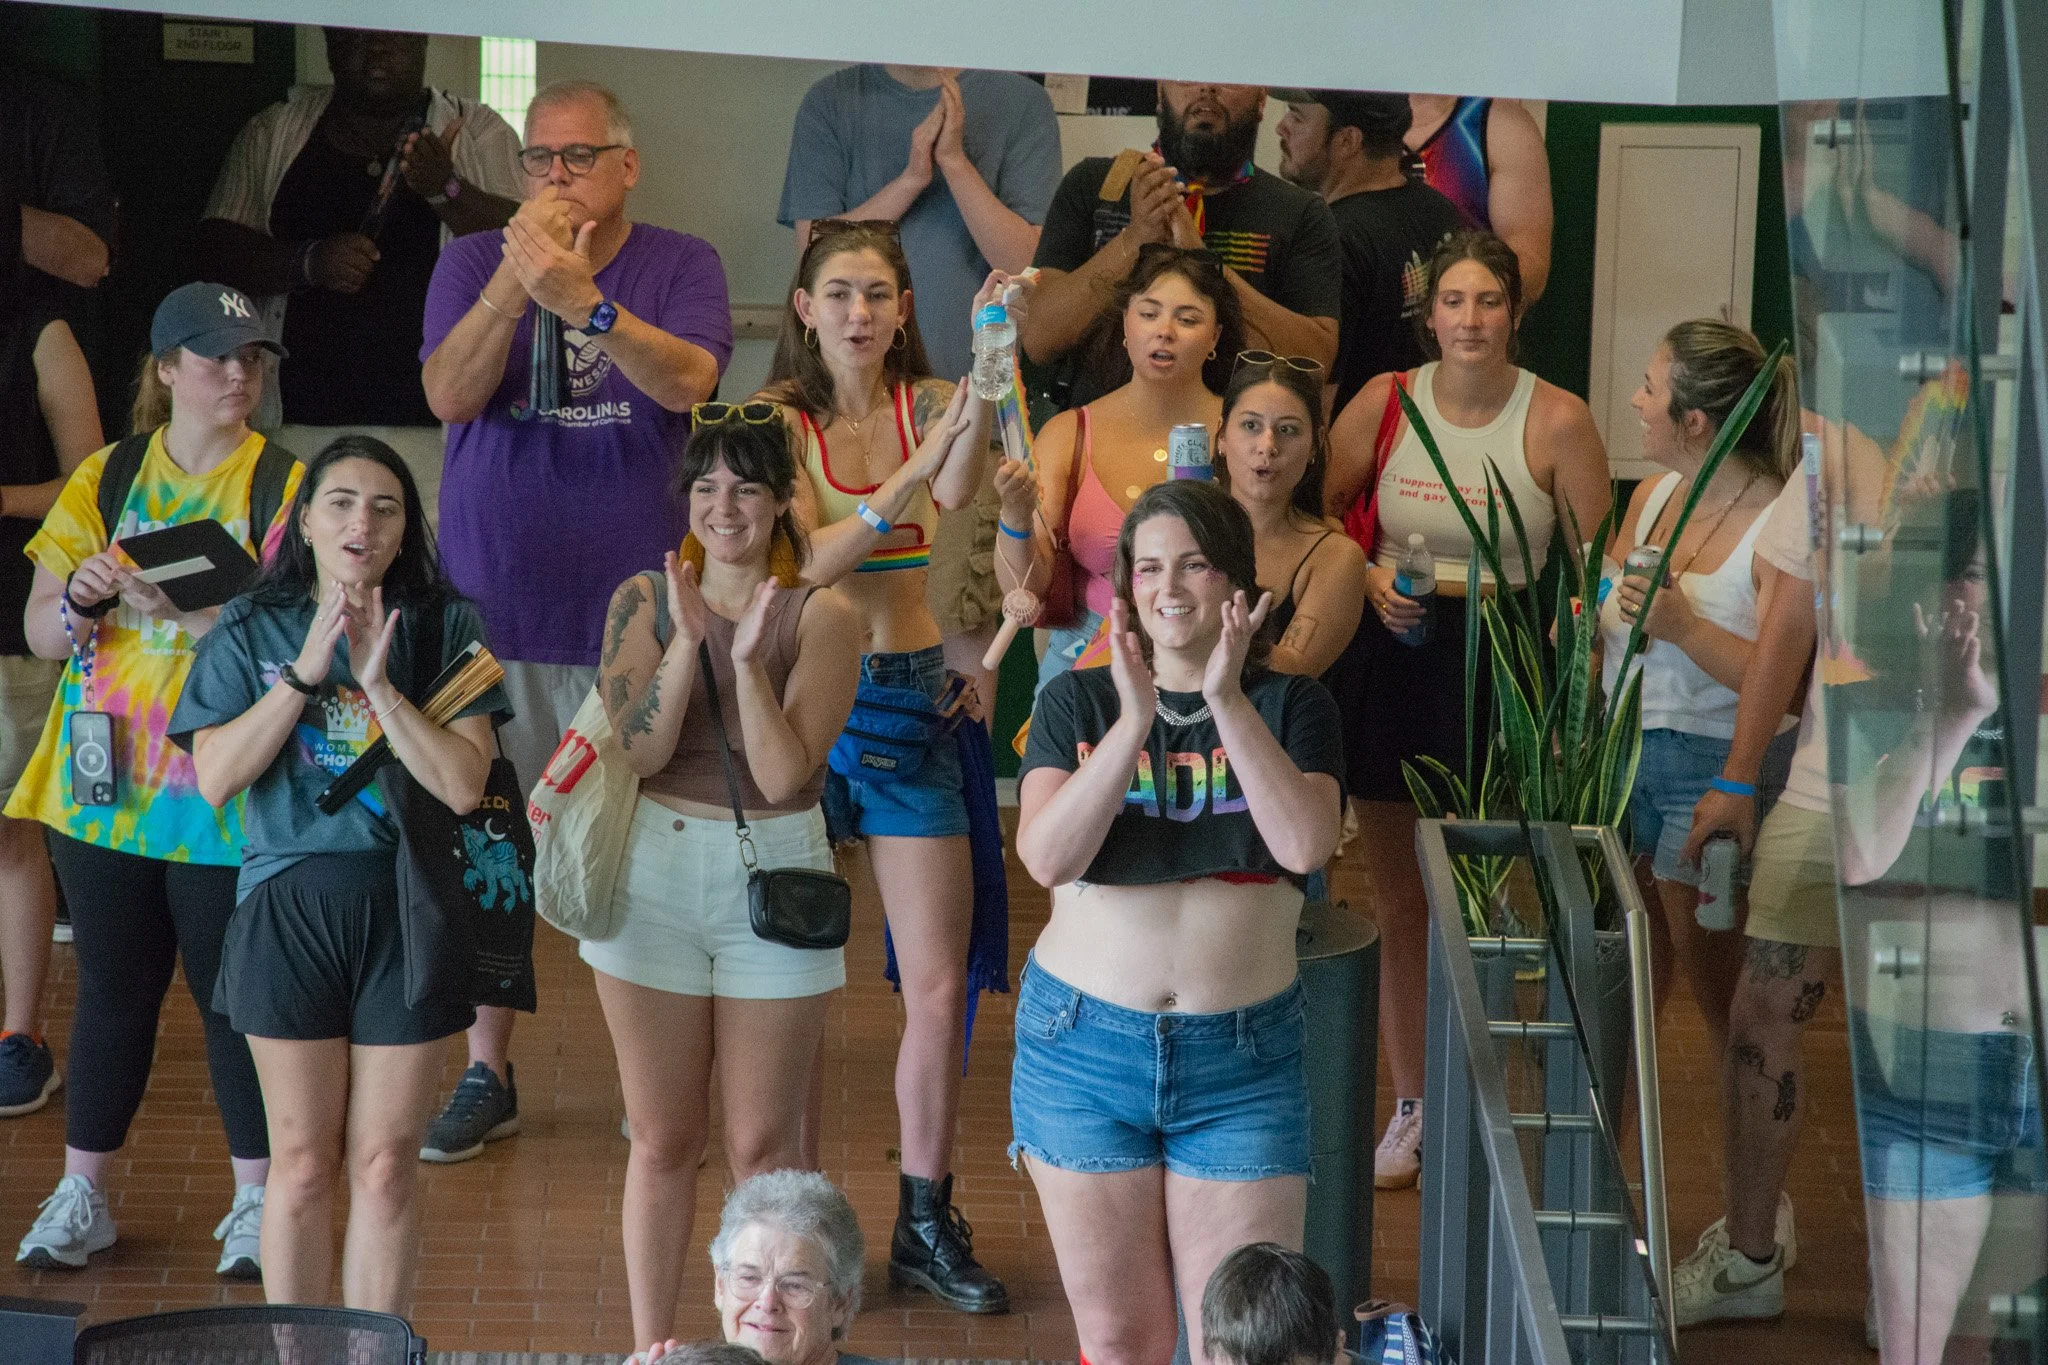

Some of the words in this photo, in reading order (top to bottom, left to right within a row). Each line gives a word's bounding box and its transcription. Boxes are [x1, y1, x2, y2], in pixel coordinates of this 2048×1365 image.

[203, 39, 242, 51] FLOOR
[219, 292, 251, 318] NY
[1399, 477, 1444, 490] support
[1456, 484, 1472, 495] ay
[1399, 488, 1419, 499] and
[1423, 491, 1447, 503] gay
[1464, 498, 1504, 509] rons
